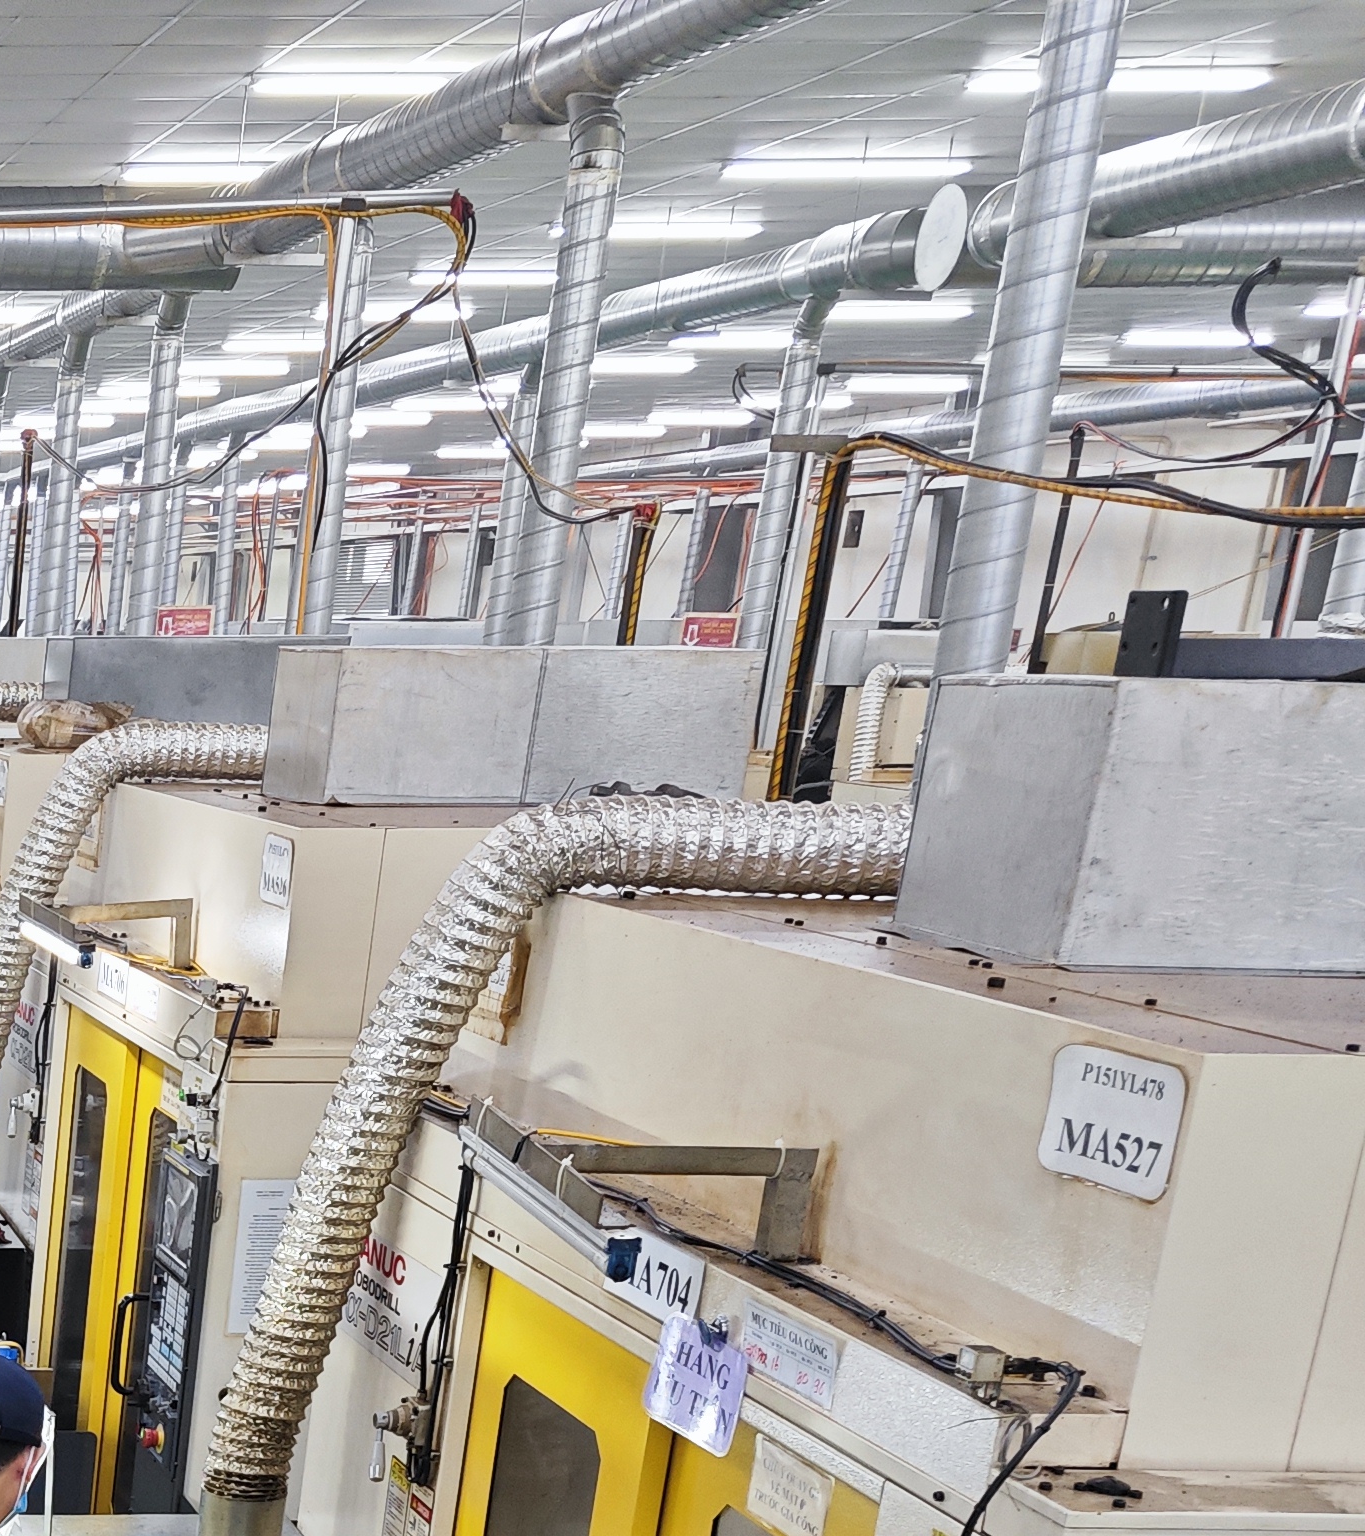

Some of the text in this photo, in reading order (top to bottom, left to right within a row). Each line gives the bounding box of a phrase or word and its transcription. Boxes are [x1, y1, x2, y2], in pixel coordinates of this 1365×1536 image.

[1081, 1062, 1165, 1101] P151YL478
[1054, 1117, 1163, 1178] MA527
[360, 1238, 407, 1286] ANUC
[627, 1255, 693, 1313] A704
[355, 1270, 401, 1316] OBODRILL
